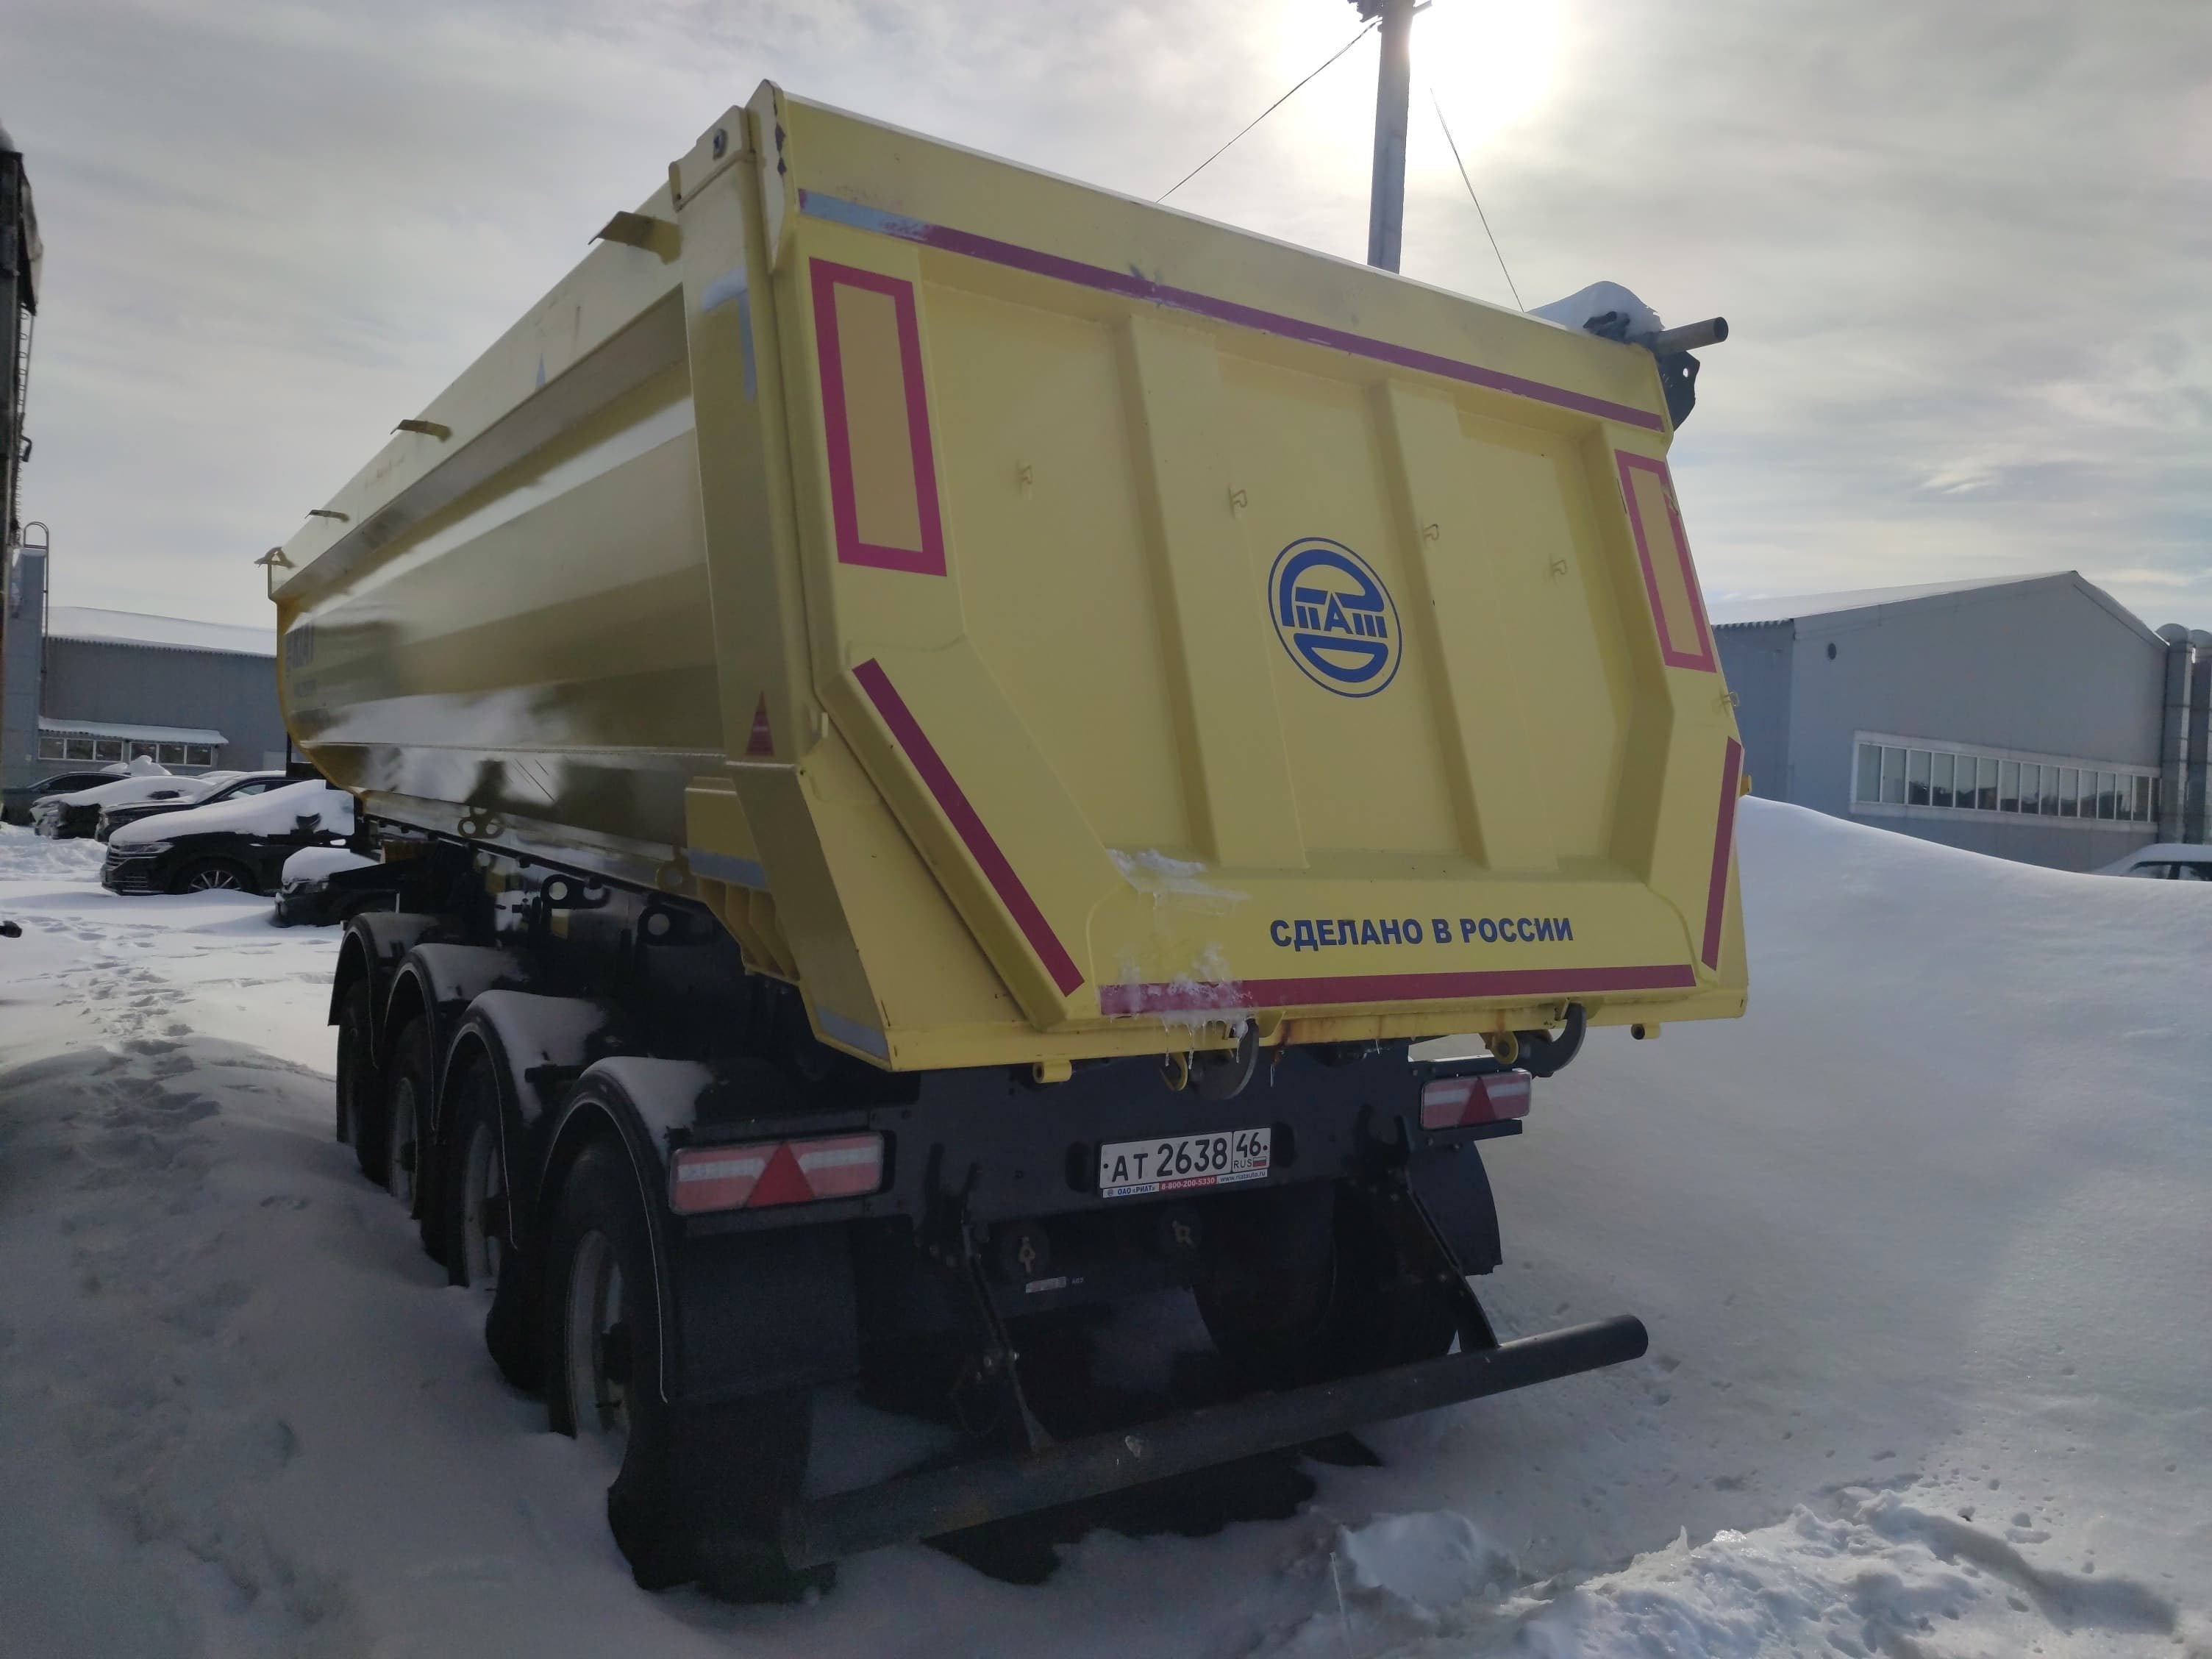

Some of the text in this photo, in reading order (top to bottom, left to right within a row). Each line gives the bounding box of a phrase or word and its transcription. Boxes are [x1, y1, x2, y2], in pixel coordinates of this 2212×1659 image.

[1270, 917, 1574, 952] СДЕЛАНО В РОССИИ
[1156, 1137, 1227, 1178] 2638
[1236, 1132, 1261, 1158] 46
[1233, 1157, 1253, 1169] RUS
[1220, 1171, 1266, 1182] www.riatauto.ru
[1161, 1177, 1215, 1190] 8-800-200-5330
[1117, 1187, 1131, 1195] ОАО
